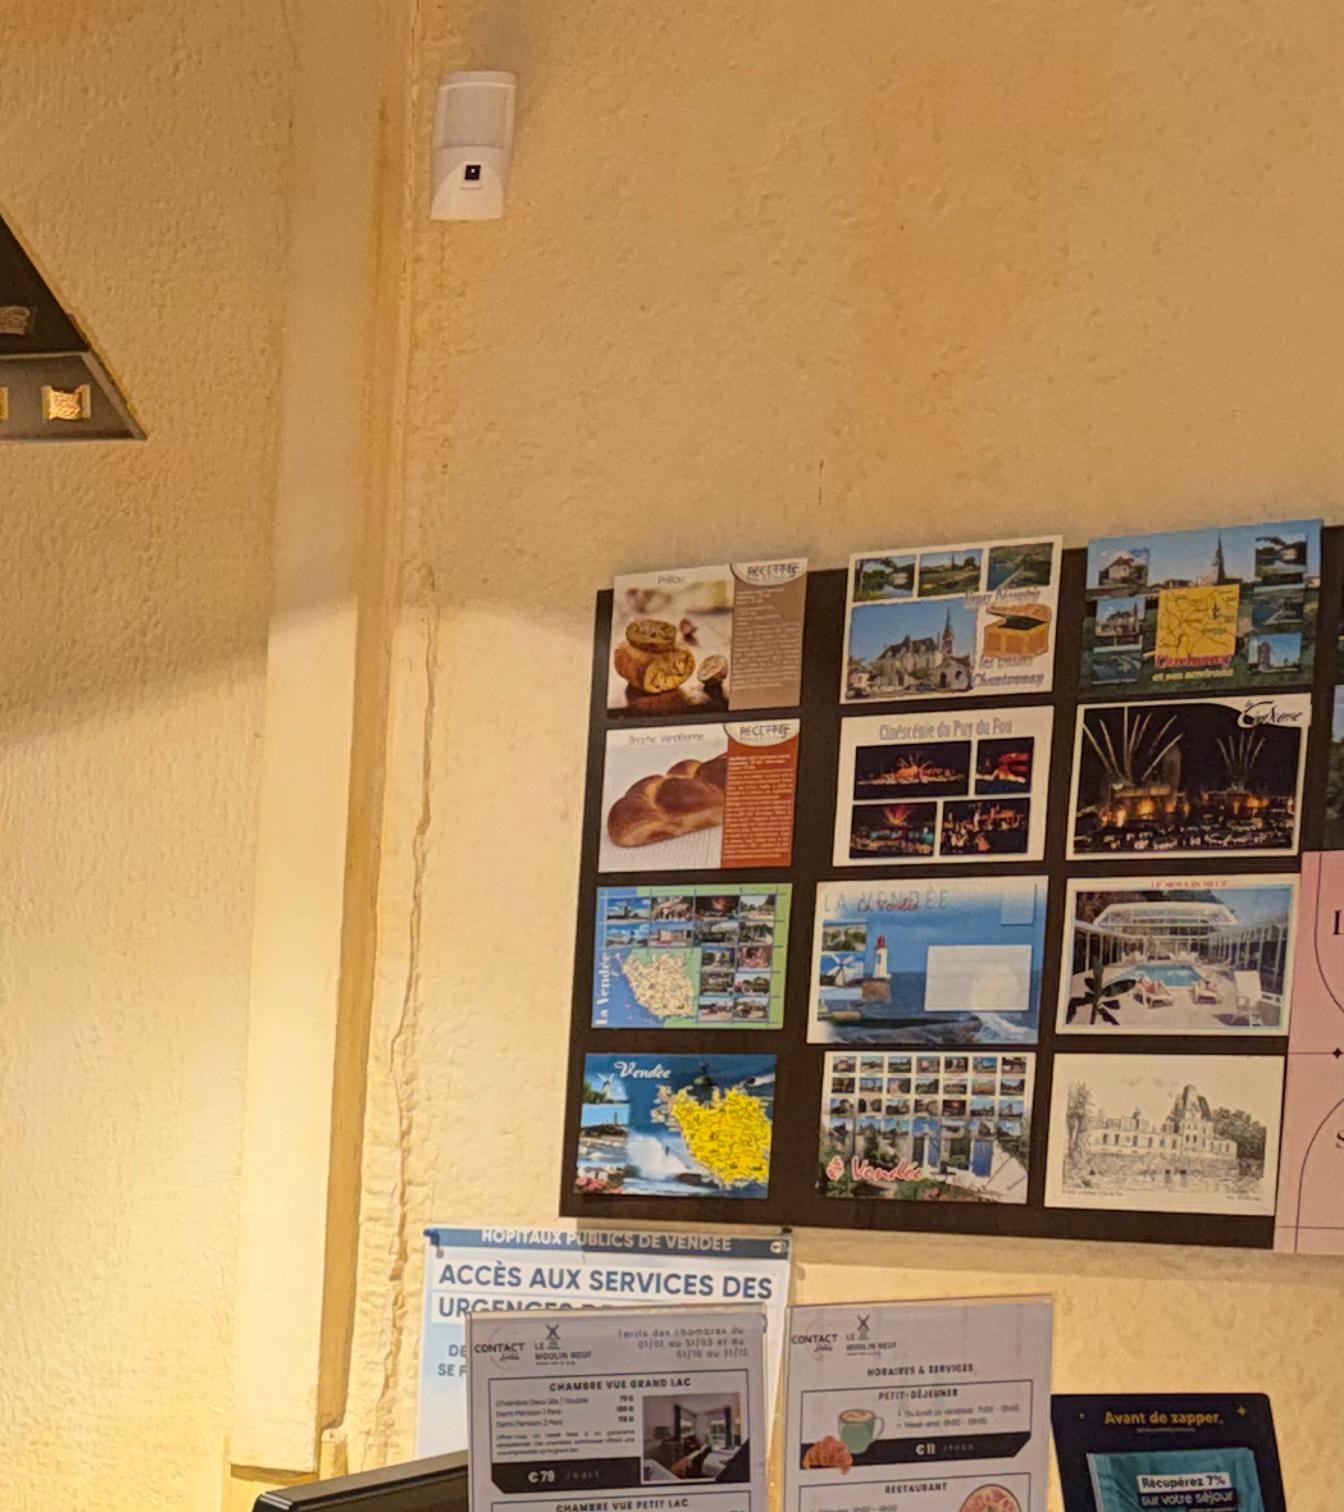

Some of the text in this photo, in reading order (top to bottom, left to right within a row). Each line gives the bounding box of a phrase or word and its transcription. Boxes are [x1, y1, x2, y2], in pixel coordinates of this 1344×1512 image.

[566, 1231, 635, 1247] PUBLICS
[638, 1235, 661, 1249] DE
[439, 1260, 773, 1300] ACCÈS AUX SERVICES DES
[534, 1342, 545, 1350] LE
[791, 1333, 838, 1345] CONTACT
[474, 1342, 526, 1353] CONTACT
[438, 1363, 455, 1377] SE
[867, 1366, 915, 1378] HORAIRES
[928, 1363, 974, 1374] SERVICES
[549, 1378, 691, 1392] CHAMBRE VUE GRAND LAC
[1104, 1410, 1146, 1425] Avant
[1149, 1410, 1168, 1424] de
[885, 1482, 948, 1494] RESTAURANT
[1140, 1475, 1205, 1489] Récupérez
[556, 1498, 689, 1512] CHAMBRE VUE PETIT LAC
[1140, 1490, 1233, 1506] sur votre séjour
